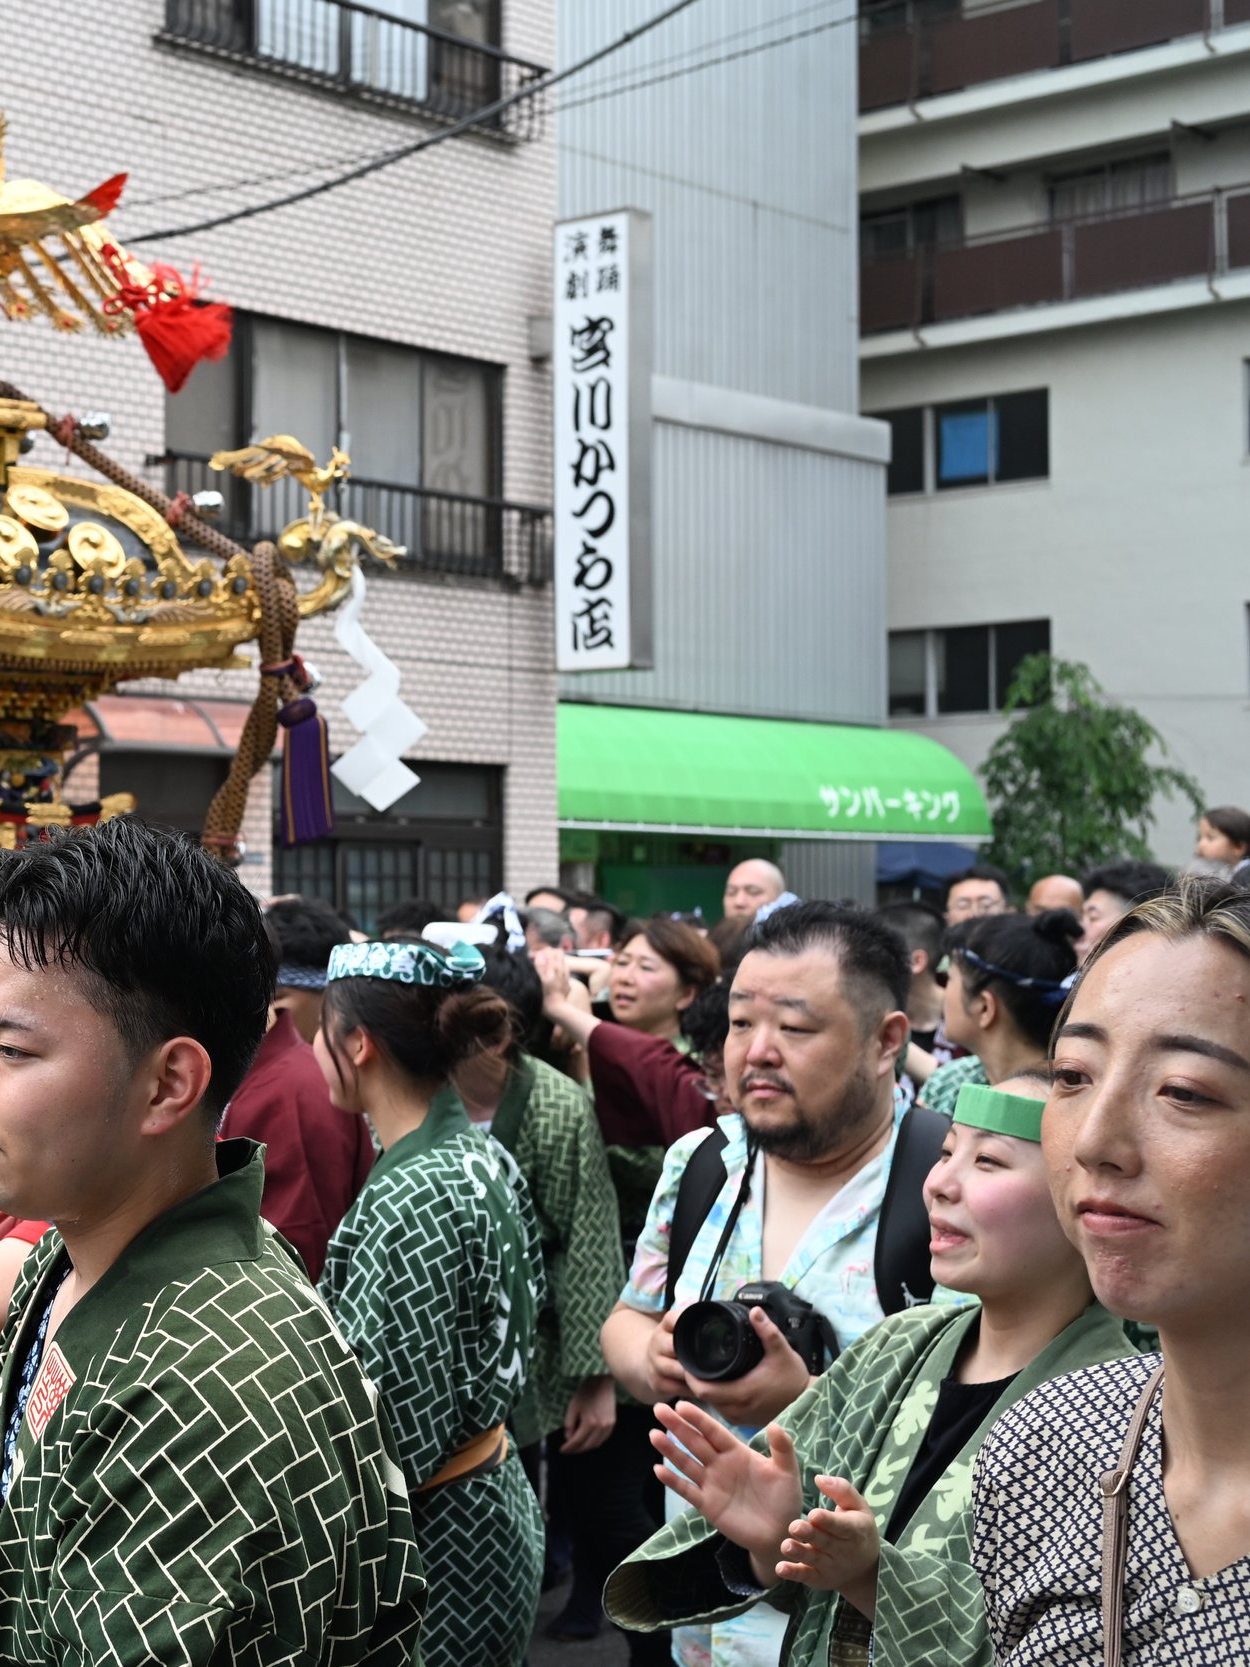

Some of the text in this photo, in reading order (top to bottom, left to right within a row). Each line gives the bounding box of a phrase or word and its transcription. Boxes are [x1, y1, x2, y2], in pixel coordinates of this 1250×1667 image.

[563, 228, 590, 302] 演劇
[596, 224, 621, 293] 舞踊
[737, 1292, 764, 1301] Canon
